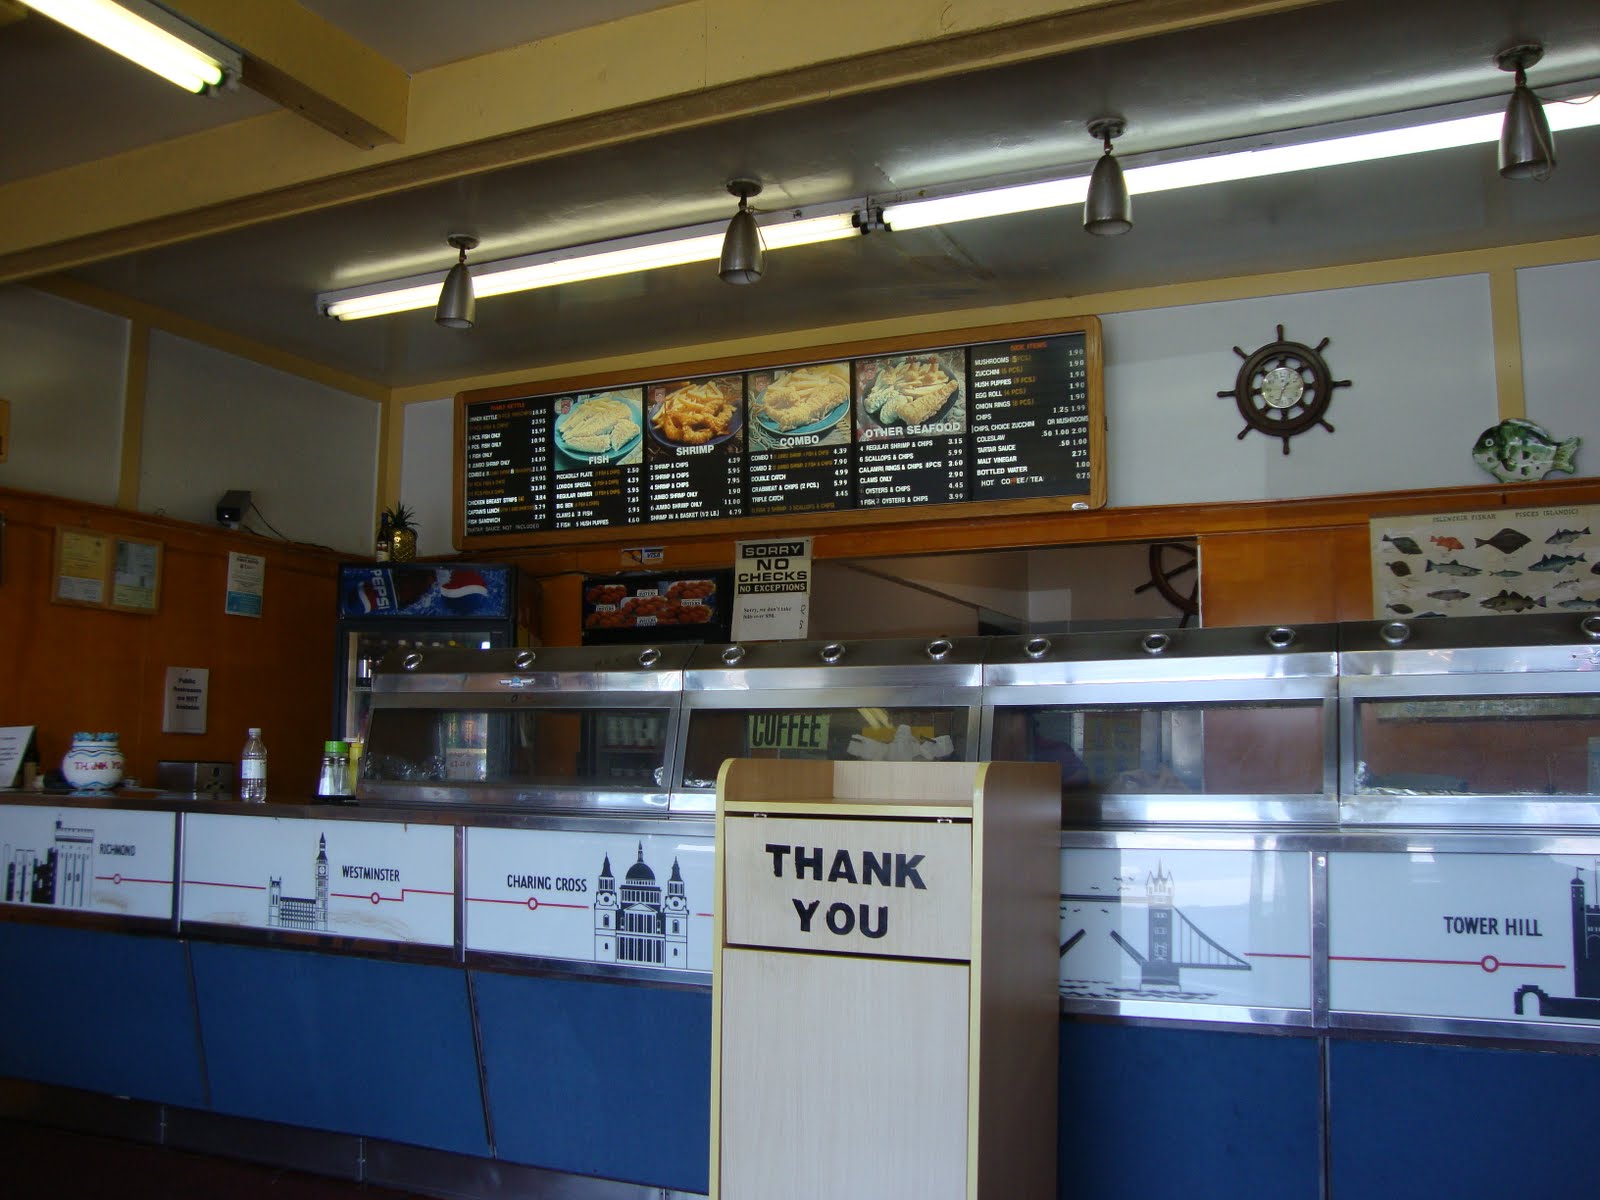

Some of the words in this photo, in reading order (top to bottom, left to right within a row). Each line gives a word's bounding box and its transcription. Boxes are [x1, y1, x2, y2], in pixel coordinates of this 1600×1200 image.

[975, 357, 1009, 366] MUSHROOMS
[975, 380, 989, 388] HUSH
[990, 378, 1011, 387] PUPPIES
[866, 426, 903, 438] OTHER
[907, 422, 960, 435] SEAFOOD
[991, 422, 1010, 431] CHOICE
[1011, 421, 1035, 429] ZUCCHINI
[780, 435, 819, 446] COMBO
[977, 434, 1005, 443] COLESLAW
[676, 444, 714, 456] SHRIMP
[589, 456, 609, 464] FISH
[977, 468, 1005, 476] BOTTLED
[745, 544, 801, 557] SORRY
[756, 558, 790, 571] NO
[738, 570, 808, 582] CHECKS
[370, 568, 390, 610] PEPSI
[754, 582, 806, 592] EXCEPTIONS
[752, 713, 821, 748] COFFEE
[100, 843, 136, 856] RICHMOND
[342, 864, 400, 882] WESTMINSTER
[765, 843, 928, 890] THANK
[506, 874, 552, 890] CHARING
[555, 878, 588, 892] CROSS
[792, 898, 888, 939] YOU
[1443, 916, 1500, 935] TOWER
[1505, 918, 1543, 936] HILL
